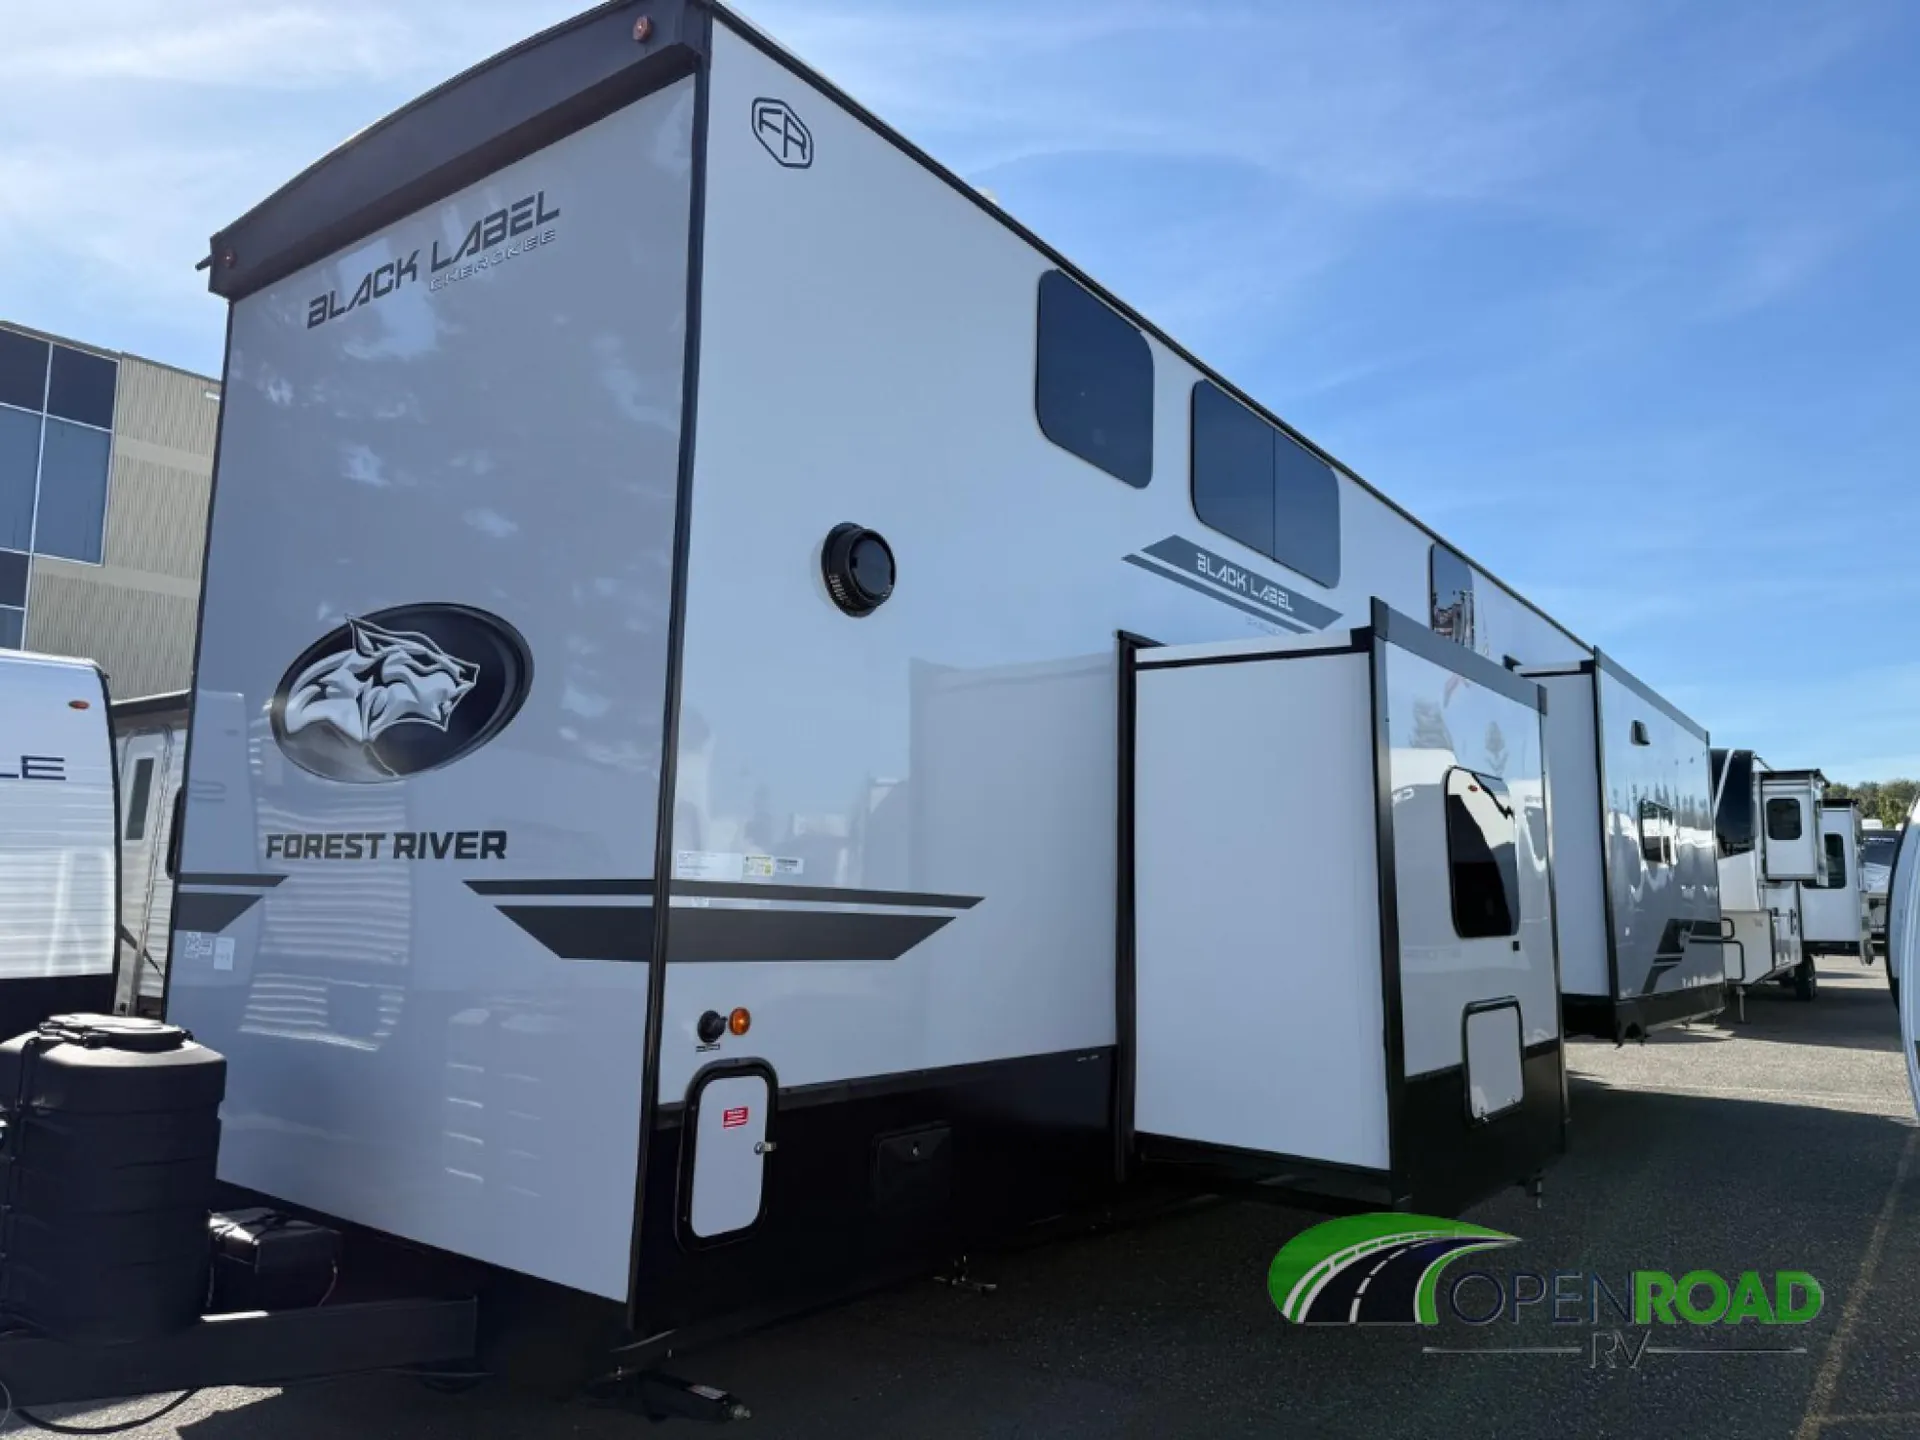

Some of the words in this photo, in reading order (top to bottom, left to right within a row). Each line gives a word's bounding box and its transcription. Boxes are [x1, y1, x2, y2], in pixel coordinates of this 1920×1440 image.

[307, 249, 420, 329] BLACK
[430, 190, 560, 273] LABEL
[1196, 552, 1247, 592] BLACK
[1250, 577, 1295, 612] LABEL
[266, 832, 386, 860] FOREST
[392, 830, 507, 860] RIVER
